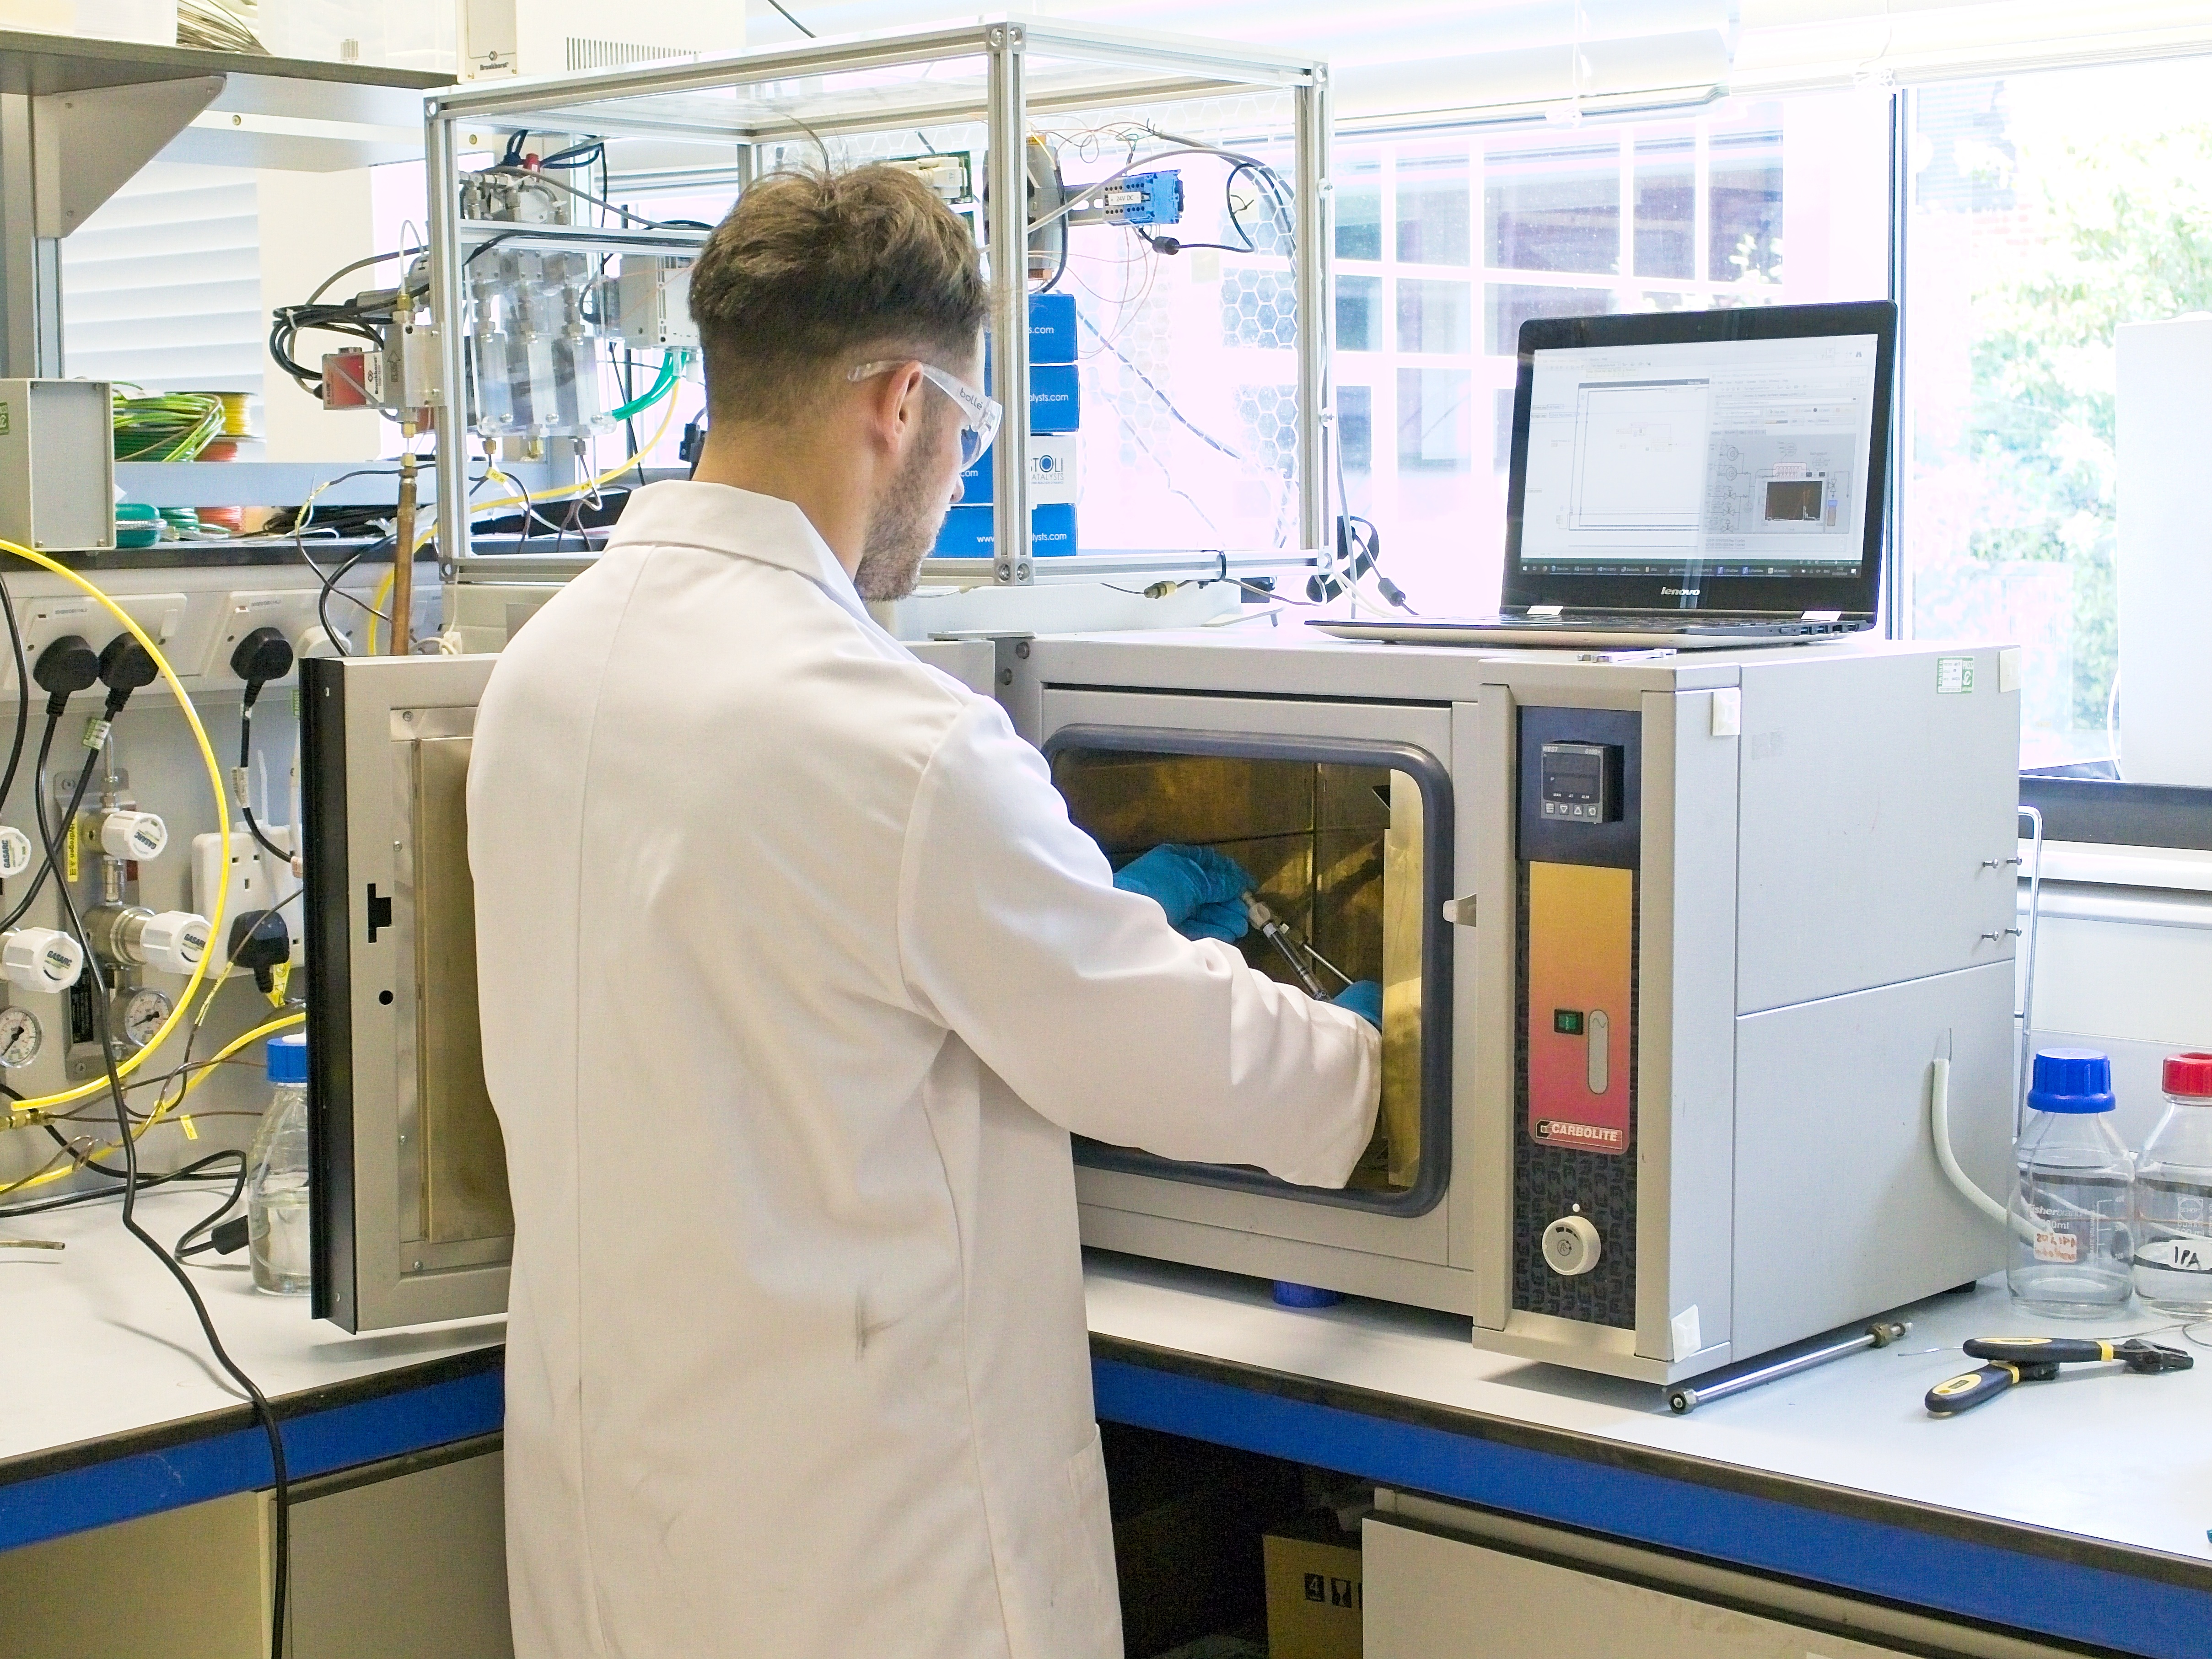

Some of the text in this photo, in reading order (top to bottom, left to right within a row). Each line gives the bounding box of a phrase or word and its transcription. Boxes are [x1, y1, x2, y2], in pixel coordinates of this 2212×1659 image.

[1031, 455, 1063, 472] TOLI
[1661, 587, 1701, 596] lenovo
[134, 832, 157, 850] GASARC
[2, 840, 11, 868] GASARC
[184, 934, 206, 948] GASAR
[47, 950, 72, 967] GASARC
[1552, 1123, 1618, 1142] CARBOLITE
[2175, 1246, 2202, 1270] IPA
